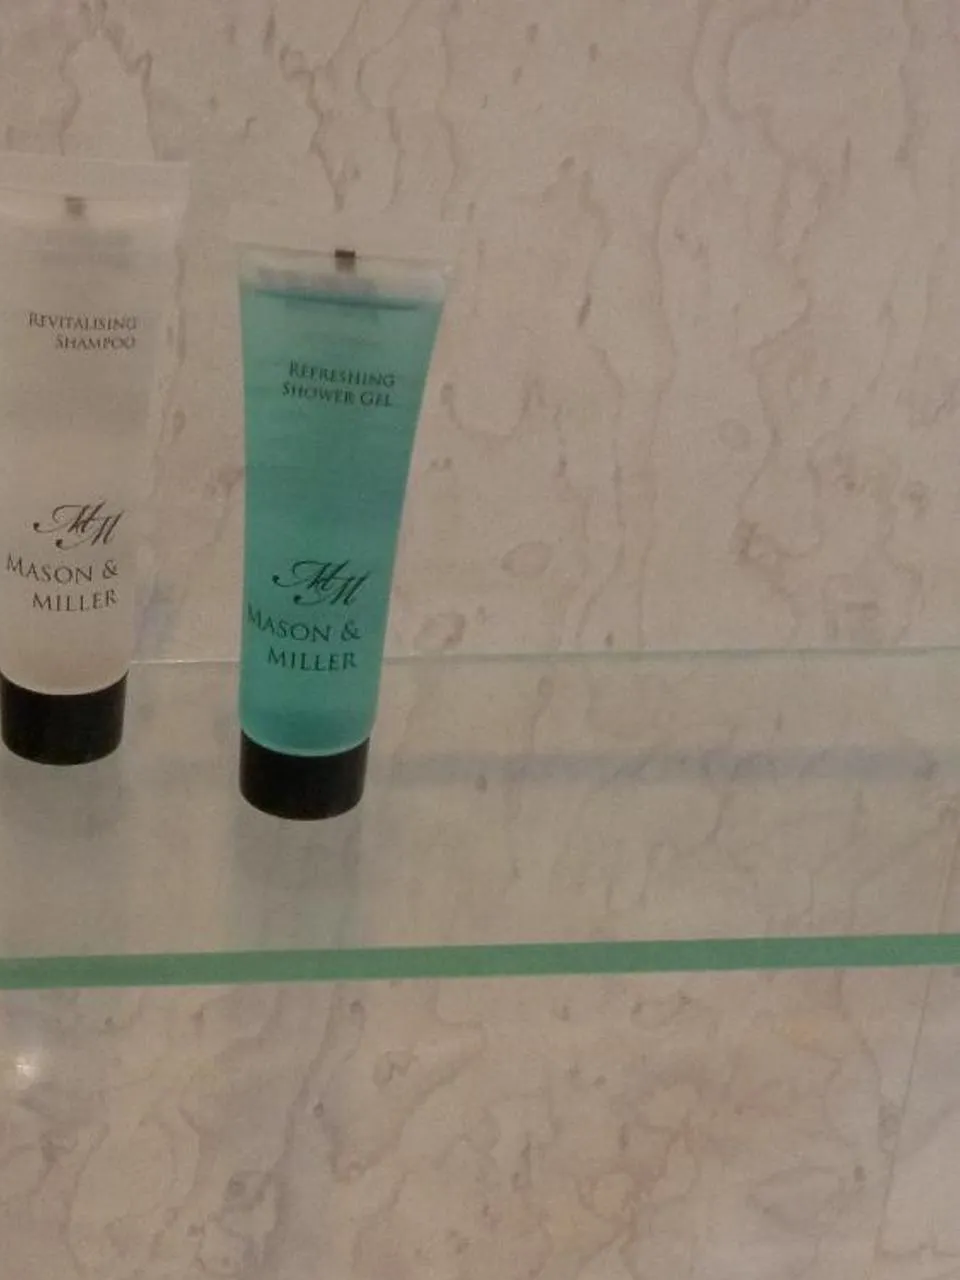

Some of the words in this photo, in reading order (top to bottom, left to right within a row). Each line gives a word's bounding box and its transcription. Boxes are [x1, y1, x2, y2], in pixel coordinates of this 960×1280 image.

[28, 312, 137, 331] REVITALISING
[55, 333, 137, 351] SHAMPOO
[288, 361, 396, 388] REFRESHING
[282, 381, 355, 405] SHOWER
[360, 391, 393, 408] GEL
[6, 553, 94, 584] MASON
[102, 558, 118, 578] &
[32, 588, 118, 612] MILLER
[246, 604, 333, 643] MASON
[342, 622, 361, 641] &
[267, 646, 357, 671] MILLER
